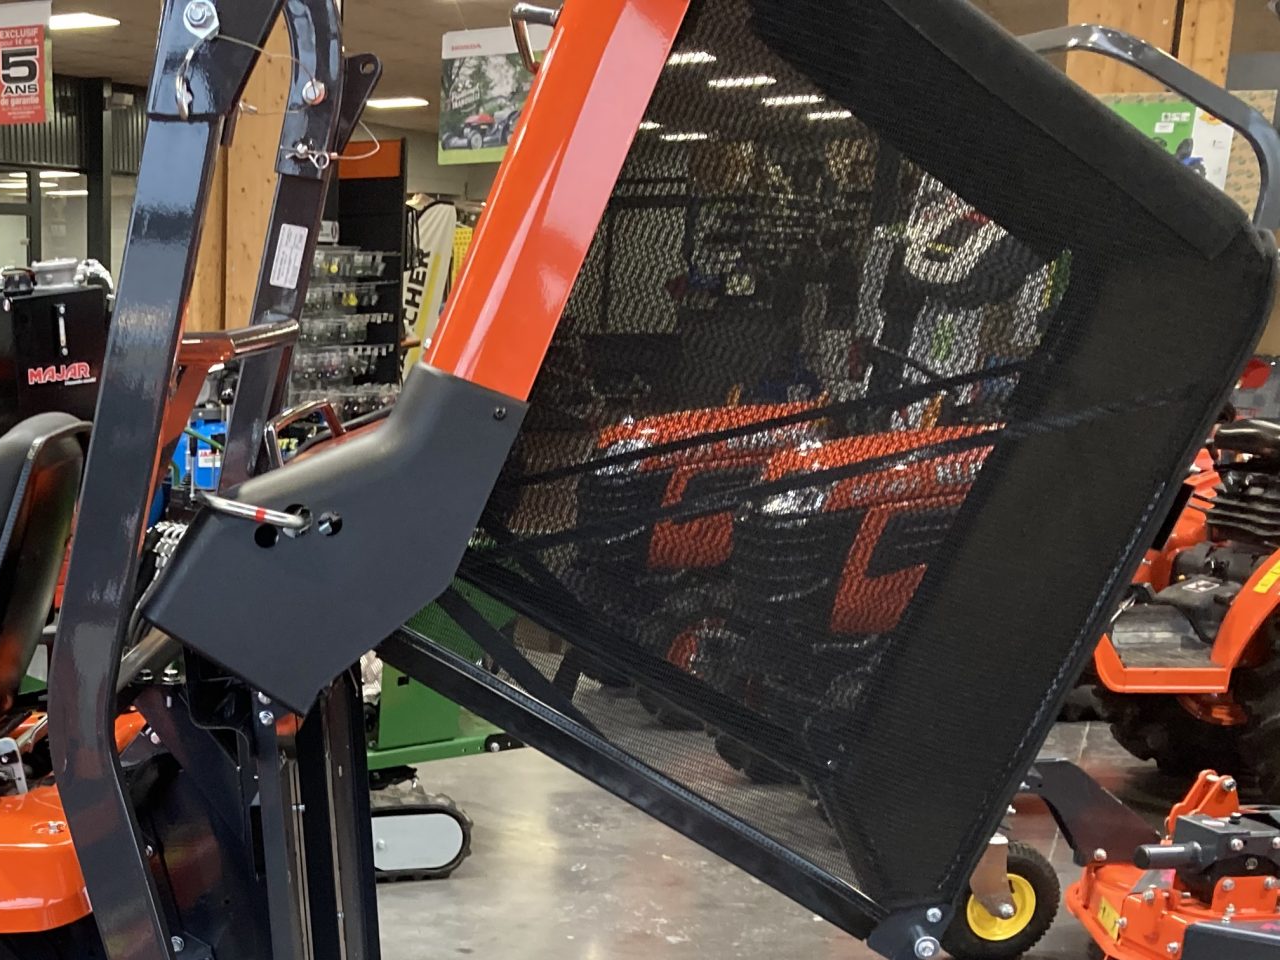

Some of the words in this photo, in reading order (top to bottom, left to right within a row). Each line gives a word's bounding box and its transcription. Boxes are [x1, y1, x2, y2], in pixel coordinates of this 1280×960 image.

[0, 28, 39, 39] EXCLUSIF
[0, 46, 39, 84] 5
[3, 83, 38, 95] ANS
[10, 96, 39, 107] garantie
[28, 362, 90, 385] MAJAR
